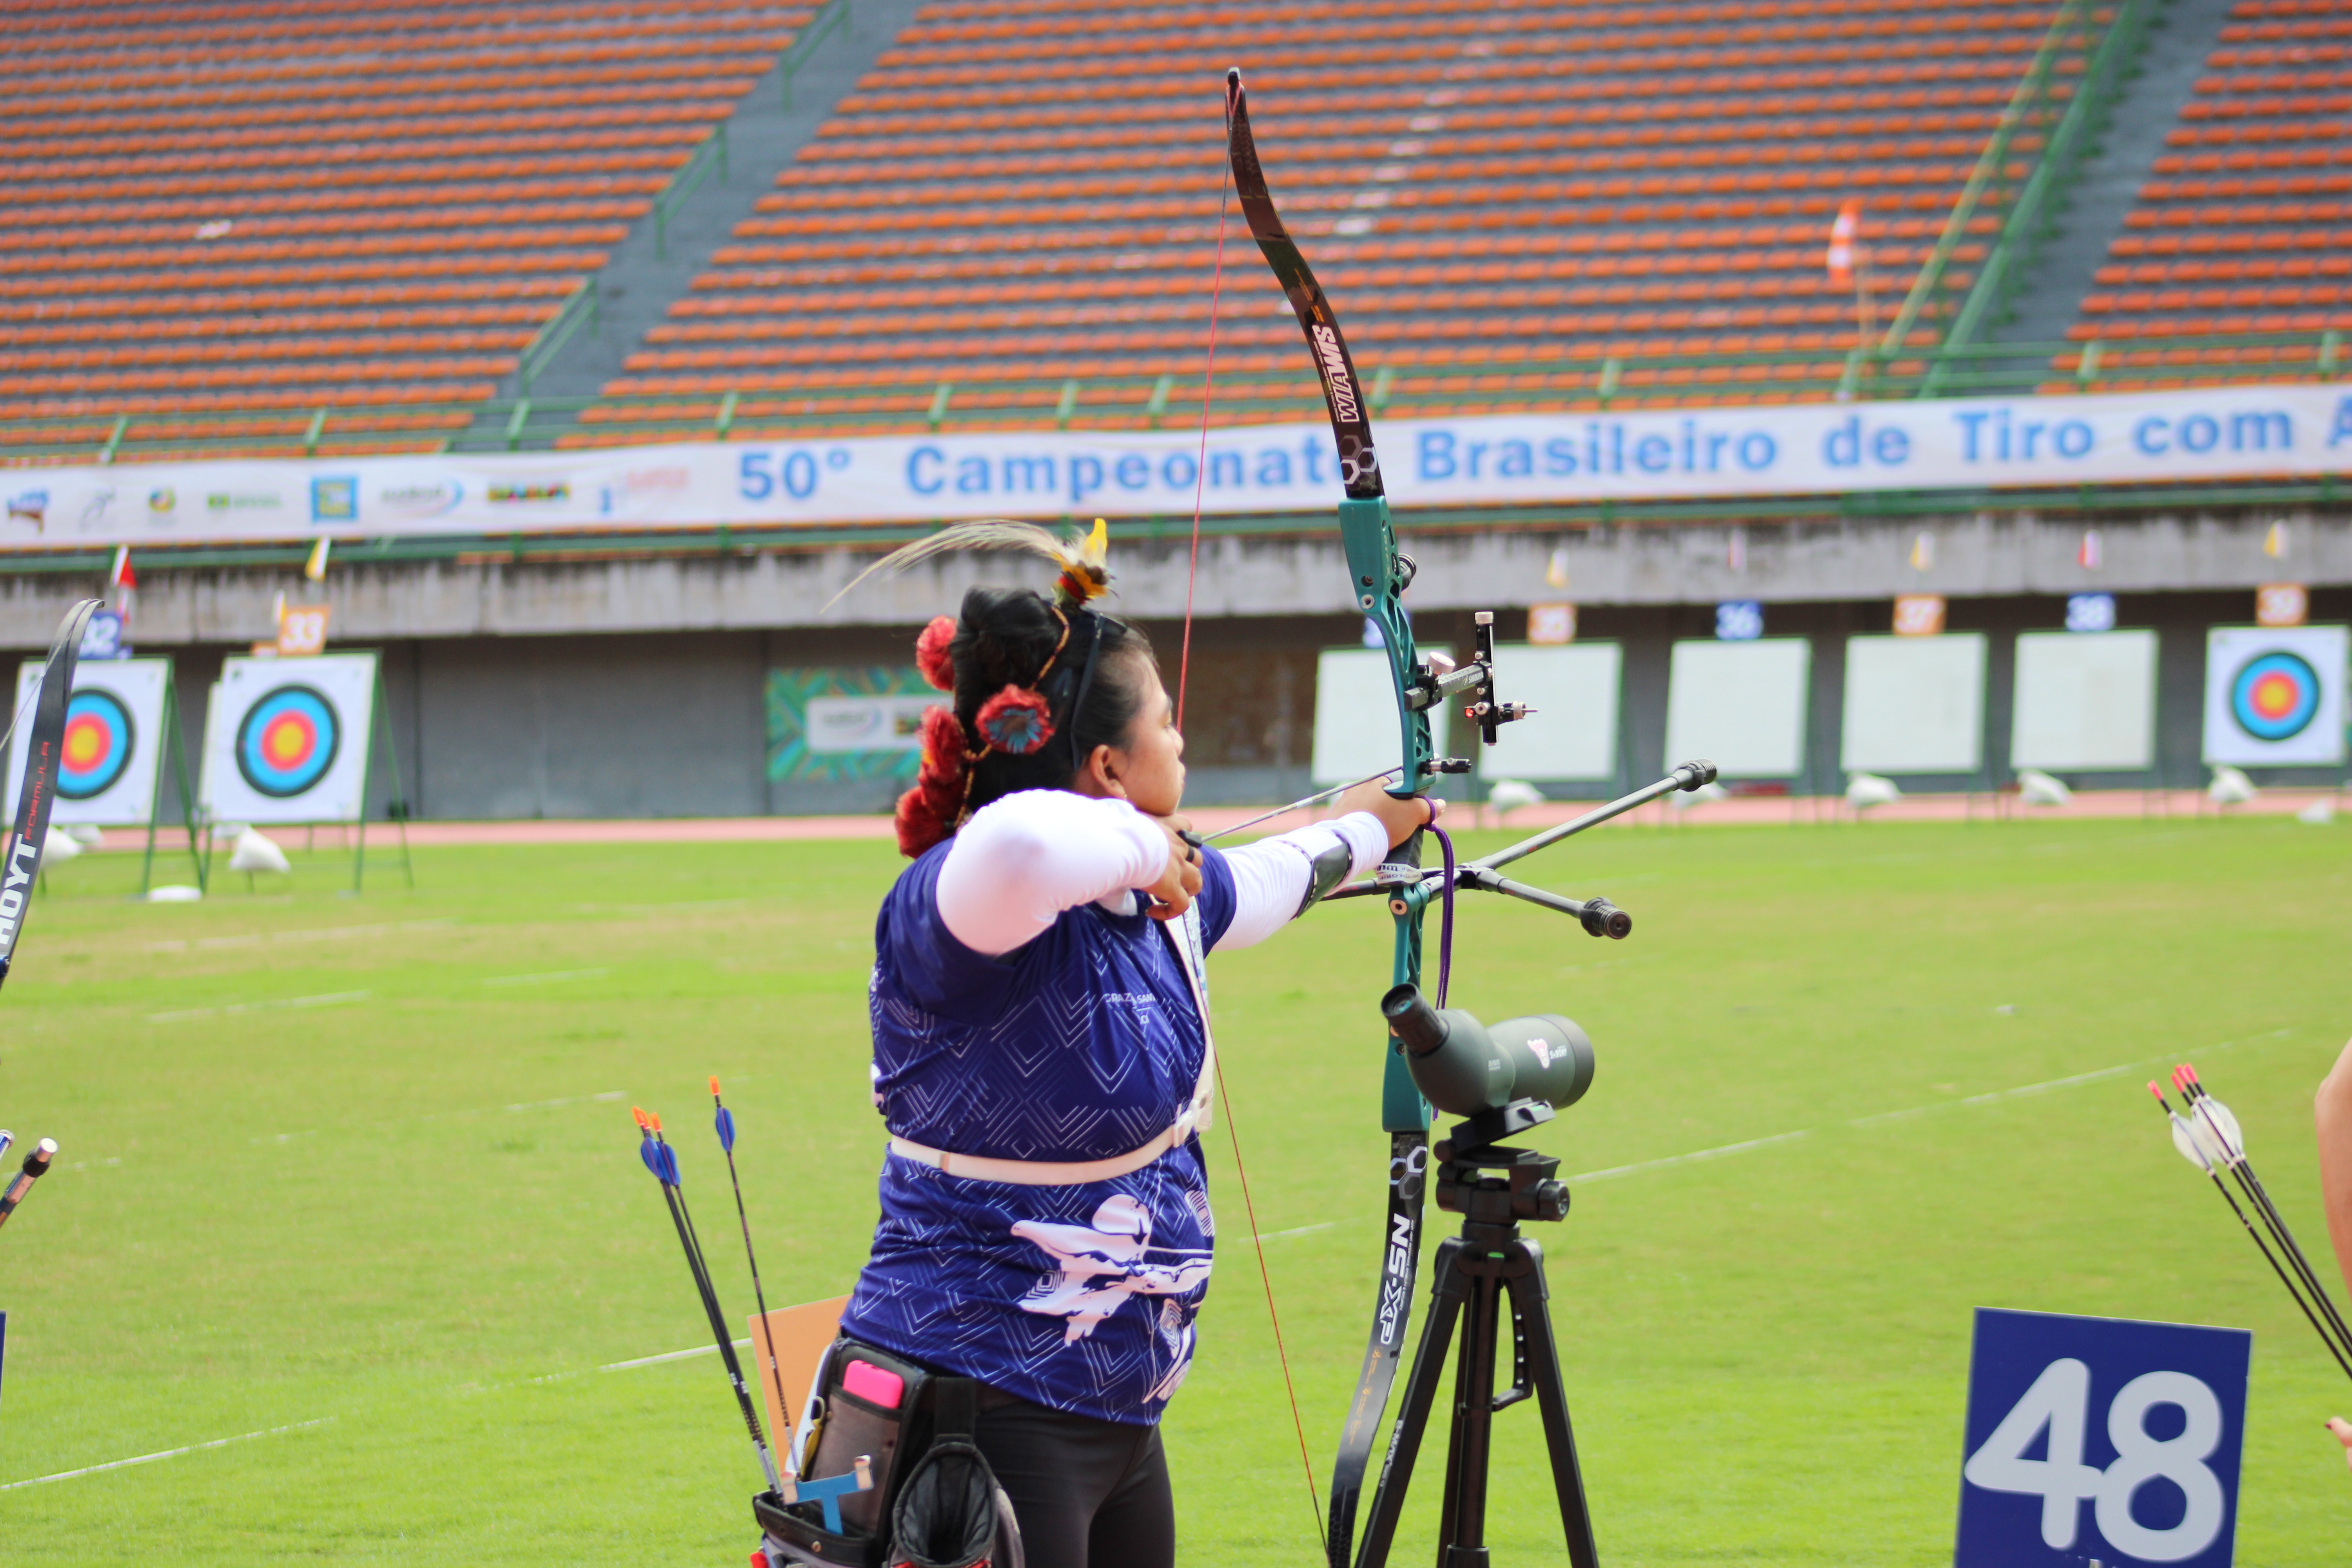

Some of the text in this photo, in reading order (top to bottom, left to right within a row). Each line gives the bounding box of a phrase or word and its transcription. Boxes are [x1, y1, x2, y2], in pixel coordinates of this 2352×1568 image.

[1312, 325, 1360, 422] WIAWIS
[1417, 418, 1779, 481] Brasileiro
[1821, 414, 1911, 468] de
[1954, 406, 2097, 462] Tiro
[2130, 409, 2295, 458] com
[284, 612, 324, 653] 33
[1717, 604, 1763, 639] 36
[1895, 597, 1944, 633] 37
[2067, 596, 2116, 631] 38
[2258, 586, 2308, 625] 39
[1468, 671, 1484, 684] SHIBUYA
[24, 741, 51, 840] FORMULA
[0, 833, 36, 944] HOYT
[1379, 1213, 1410, 1345] NS-XP
[1964, 1357, 2225, 1562] 48
